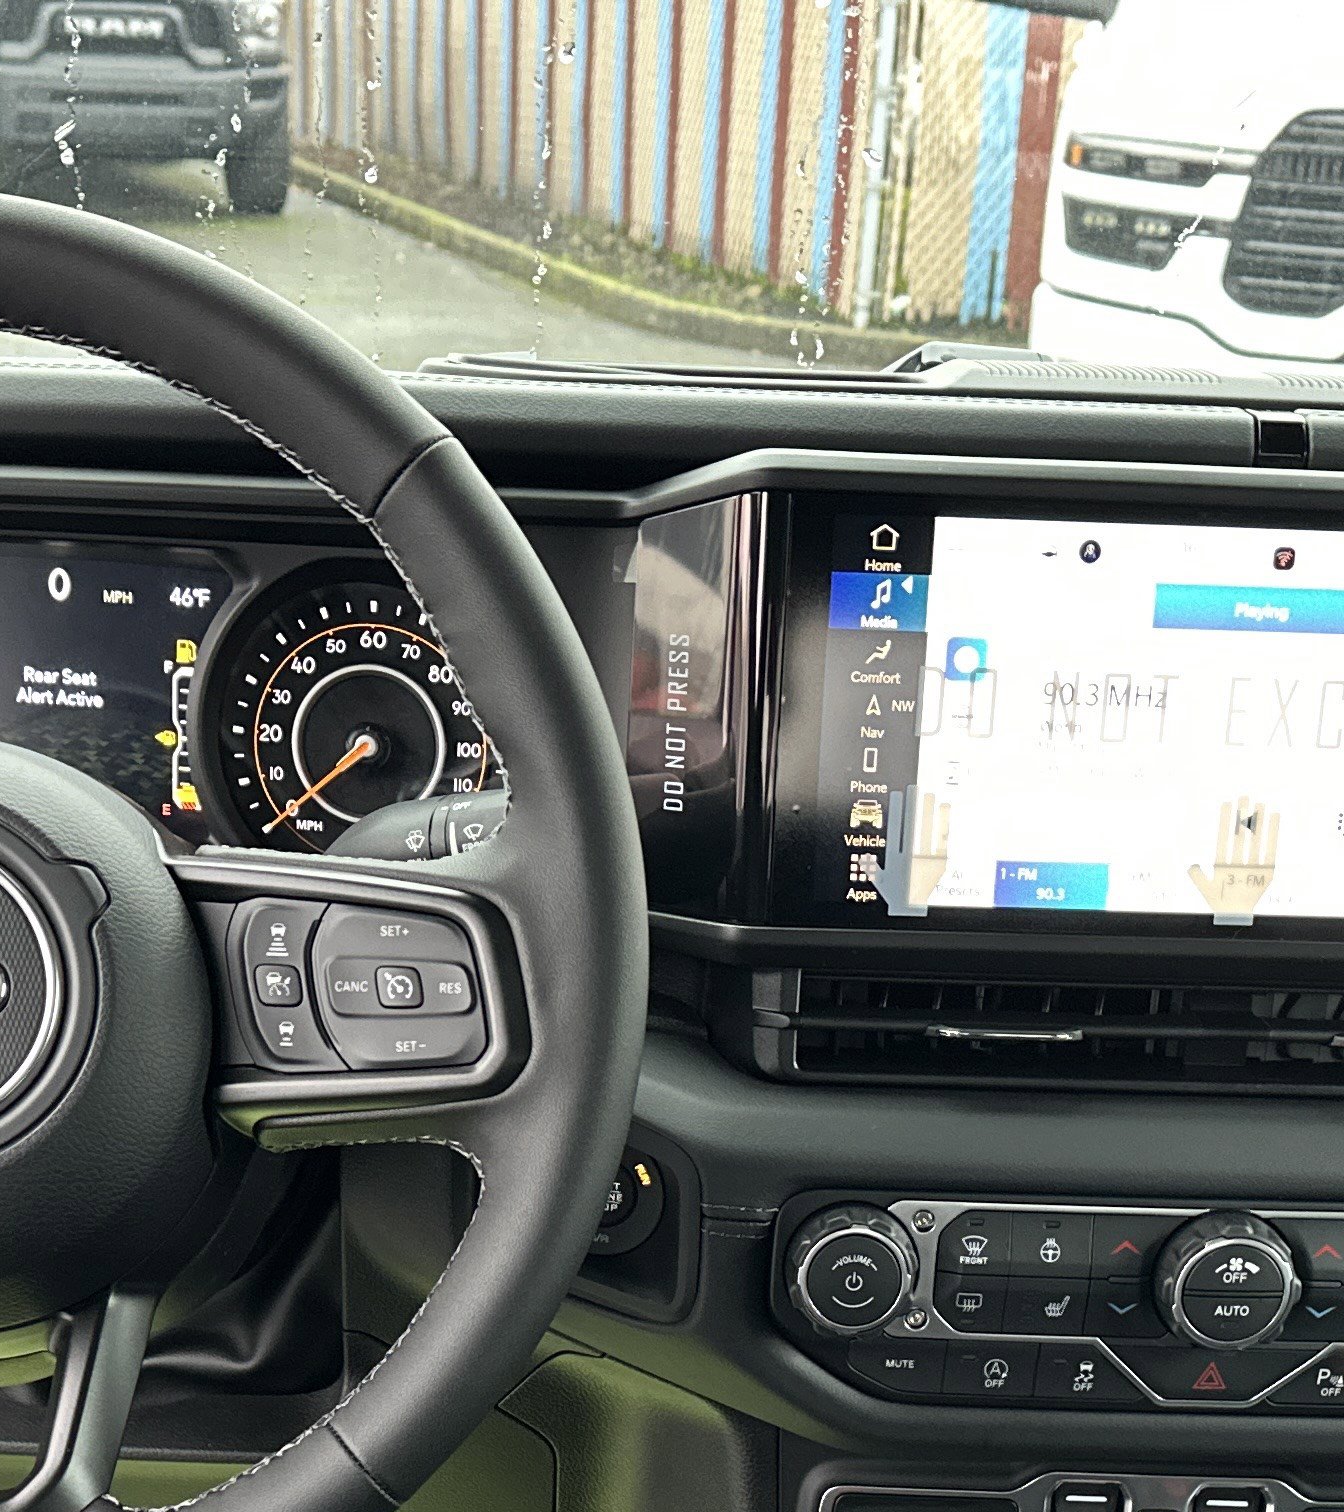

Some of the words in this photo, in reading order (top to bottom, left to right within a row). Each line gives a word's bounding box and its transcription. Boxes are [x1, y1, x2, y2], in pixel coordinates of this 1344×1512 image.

[864, 559, 902, 573] Home
[47, 567, 72, 602] 0
[102, 589, 133, 605] MPH
[1234, 600, 1290, 623] Playing
[861, 615, 899, 629] Media
[325, 638, 346, 654] 50
[359, 630, 387, 650] 60
[401, 643, 421, 660] 70
[164, 660, 173, 674] F
[291, 656, 316, 675] 40
[667, 633, 690, 712] PRESS
[23, 665, 59, 684] Rear
[61, 667, 97, 687] Seat
[427, 664, 453, 684] 80
[851, 671, 901, 685] Comfort
[15, 686, 54, 706] Alert
[55, 689, 104, 709] Active
[271, 689, 292, 705] 30
[451, 700, 471, 716] 90
[891, 699, 916, 713] NW
[915, 666, 998, 738] DO
[1049, 671, 1180, 743] NOT
[259, 723, 282, 742] 20
[861, 726, 885, 740] Nav
[456, 742, 482, 758] 100
[664, 722, 686, 770] NOT
[269, 766, 284, 781] 10
[453, 777, 473, 792] 110
[850, 781, 888, 795] Phone
[663, 780, 684, 812] DO
[162, 803, 171, 816] E
[296, 818, 323, 832] MPH
[844, 834, 887, 848] Vehicle
[1017, 868, 1038, 881] FM
[847, 888, 878, 903] Apps
[379, 925, 410, 938] SET+
[334, 980, 369, 993] CANC
[438, 982, 462, 995] RES
[835, 1254, 873, 1267] VOLUME
[959, 1256, 989, 1266] FRONT
[1222, 1272, 1249, 1284] OFF
[1214, 1305, 1250, 1317] AUTO
[885, 1359, 915, 1369] MUTE
[984, 1378, 1005, 1389] OFF
[1073, 1382, 1093, 1392] OFF
[1320, 1387, 1342, 1397] OFF
